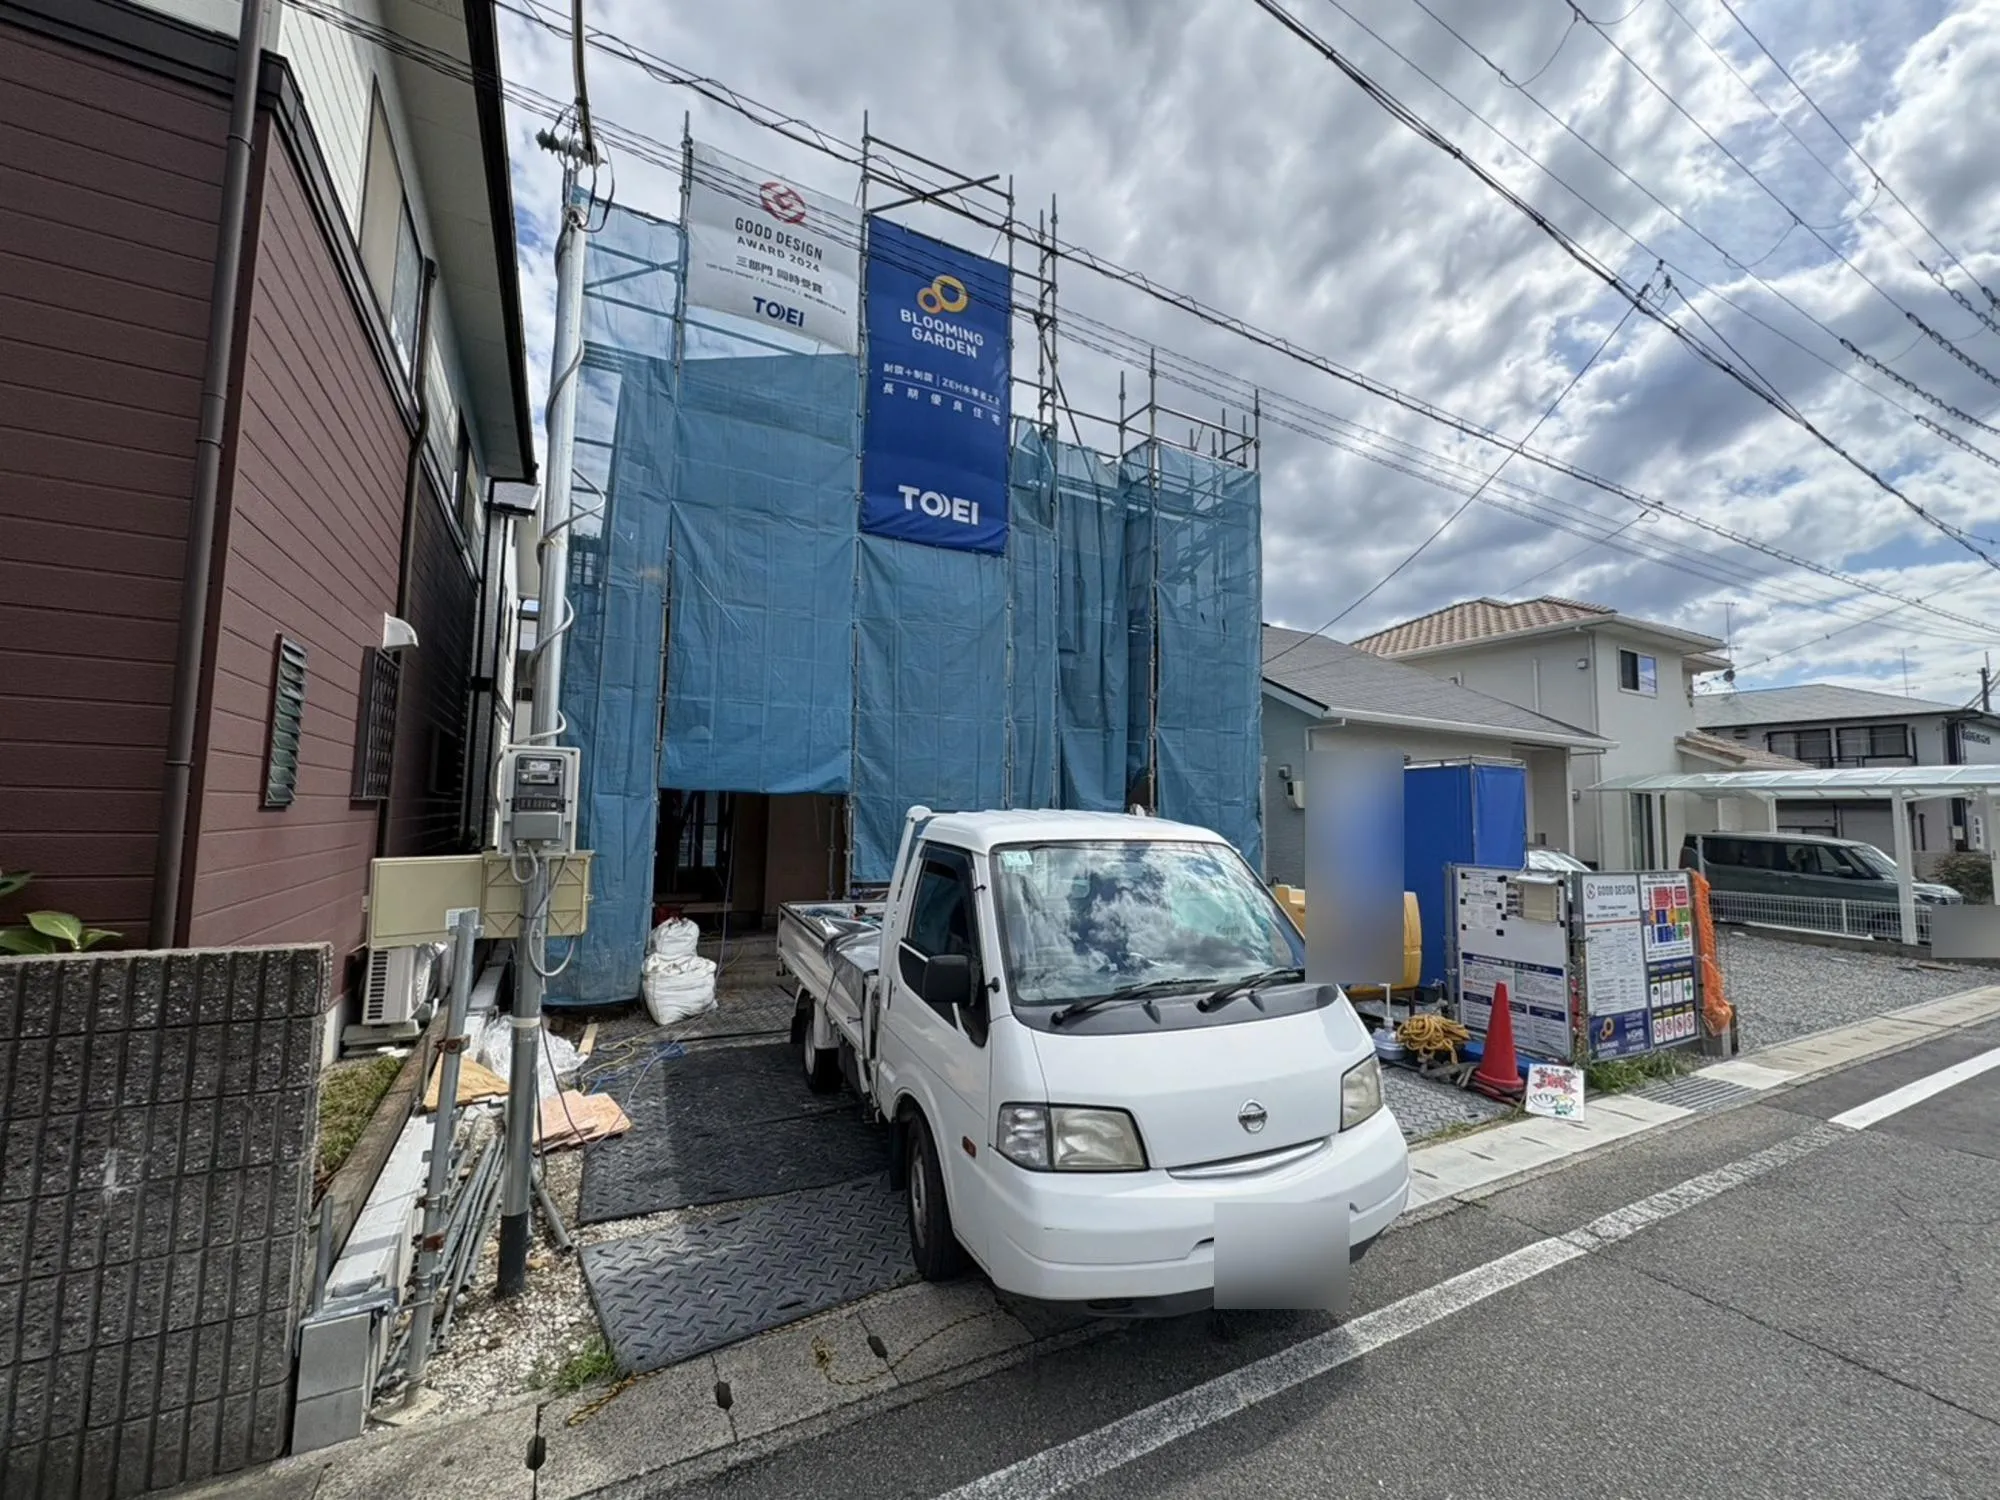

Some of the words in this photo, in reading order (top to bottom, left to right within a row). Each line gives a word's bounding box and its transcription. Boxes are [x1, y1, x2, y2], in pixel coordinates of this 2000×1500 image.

[735, 217, 772, 240] GOOD
[776, 231, 823, 261] DESIGN
[737, 236, 785, 259] AWARD
[789, 254, 821, 273] 2024
[900, 308, 984, 346] BLOOMING
[911, 327, 977, 358] GARDEN
